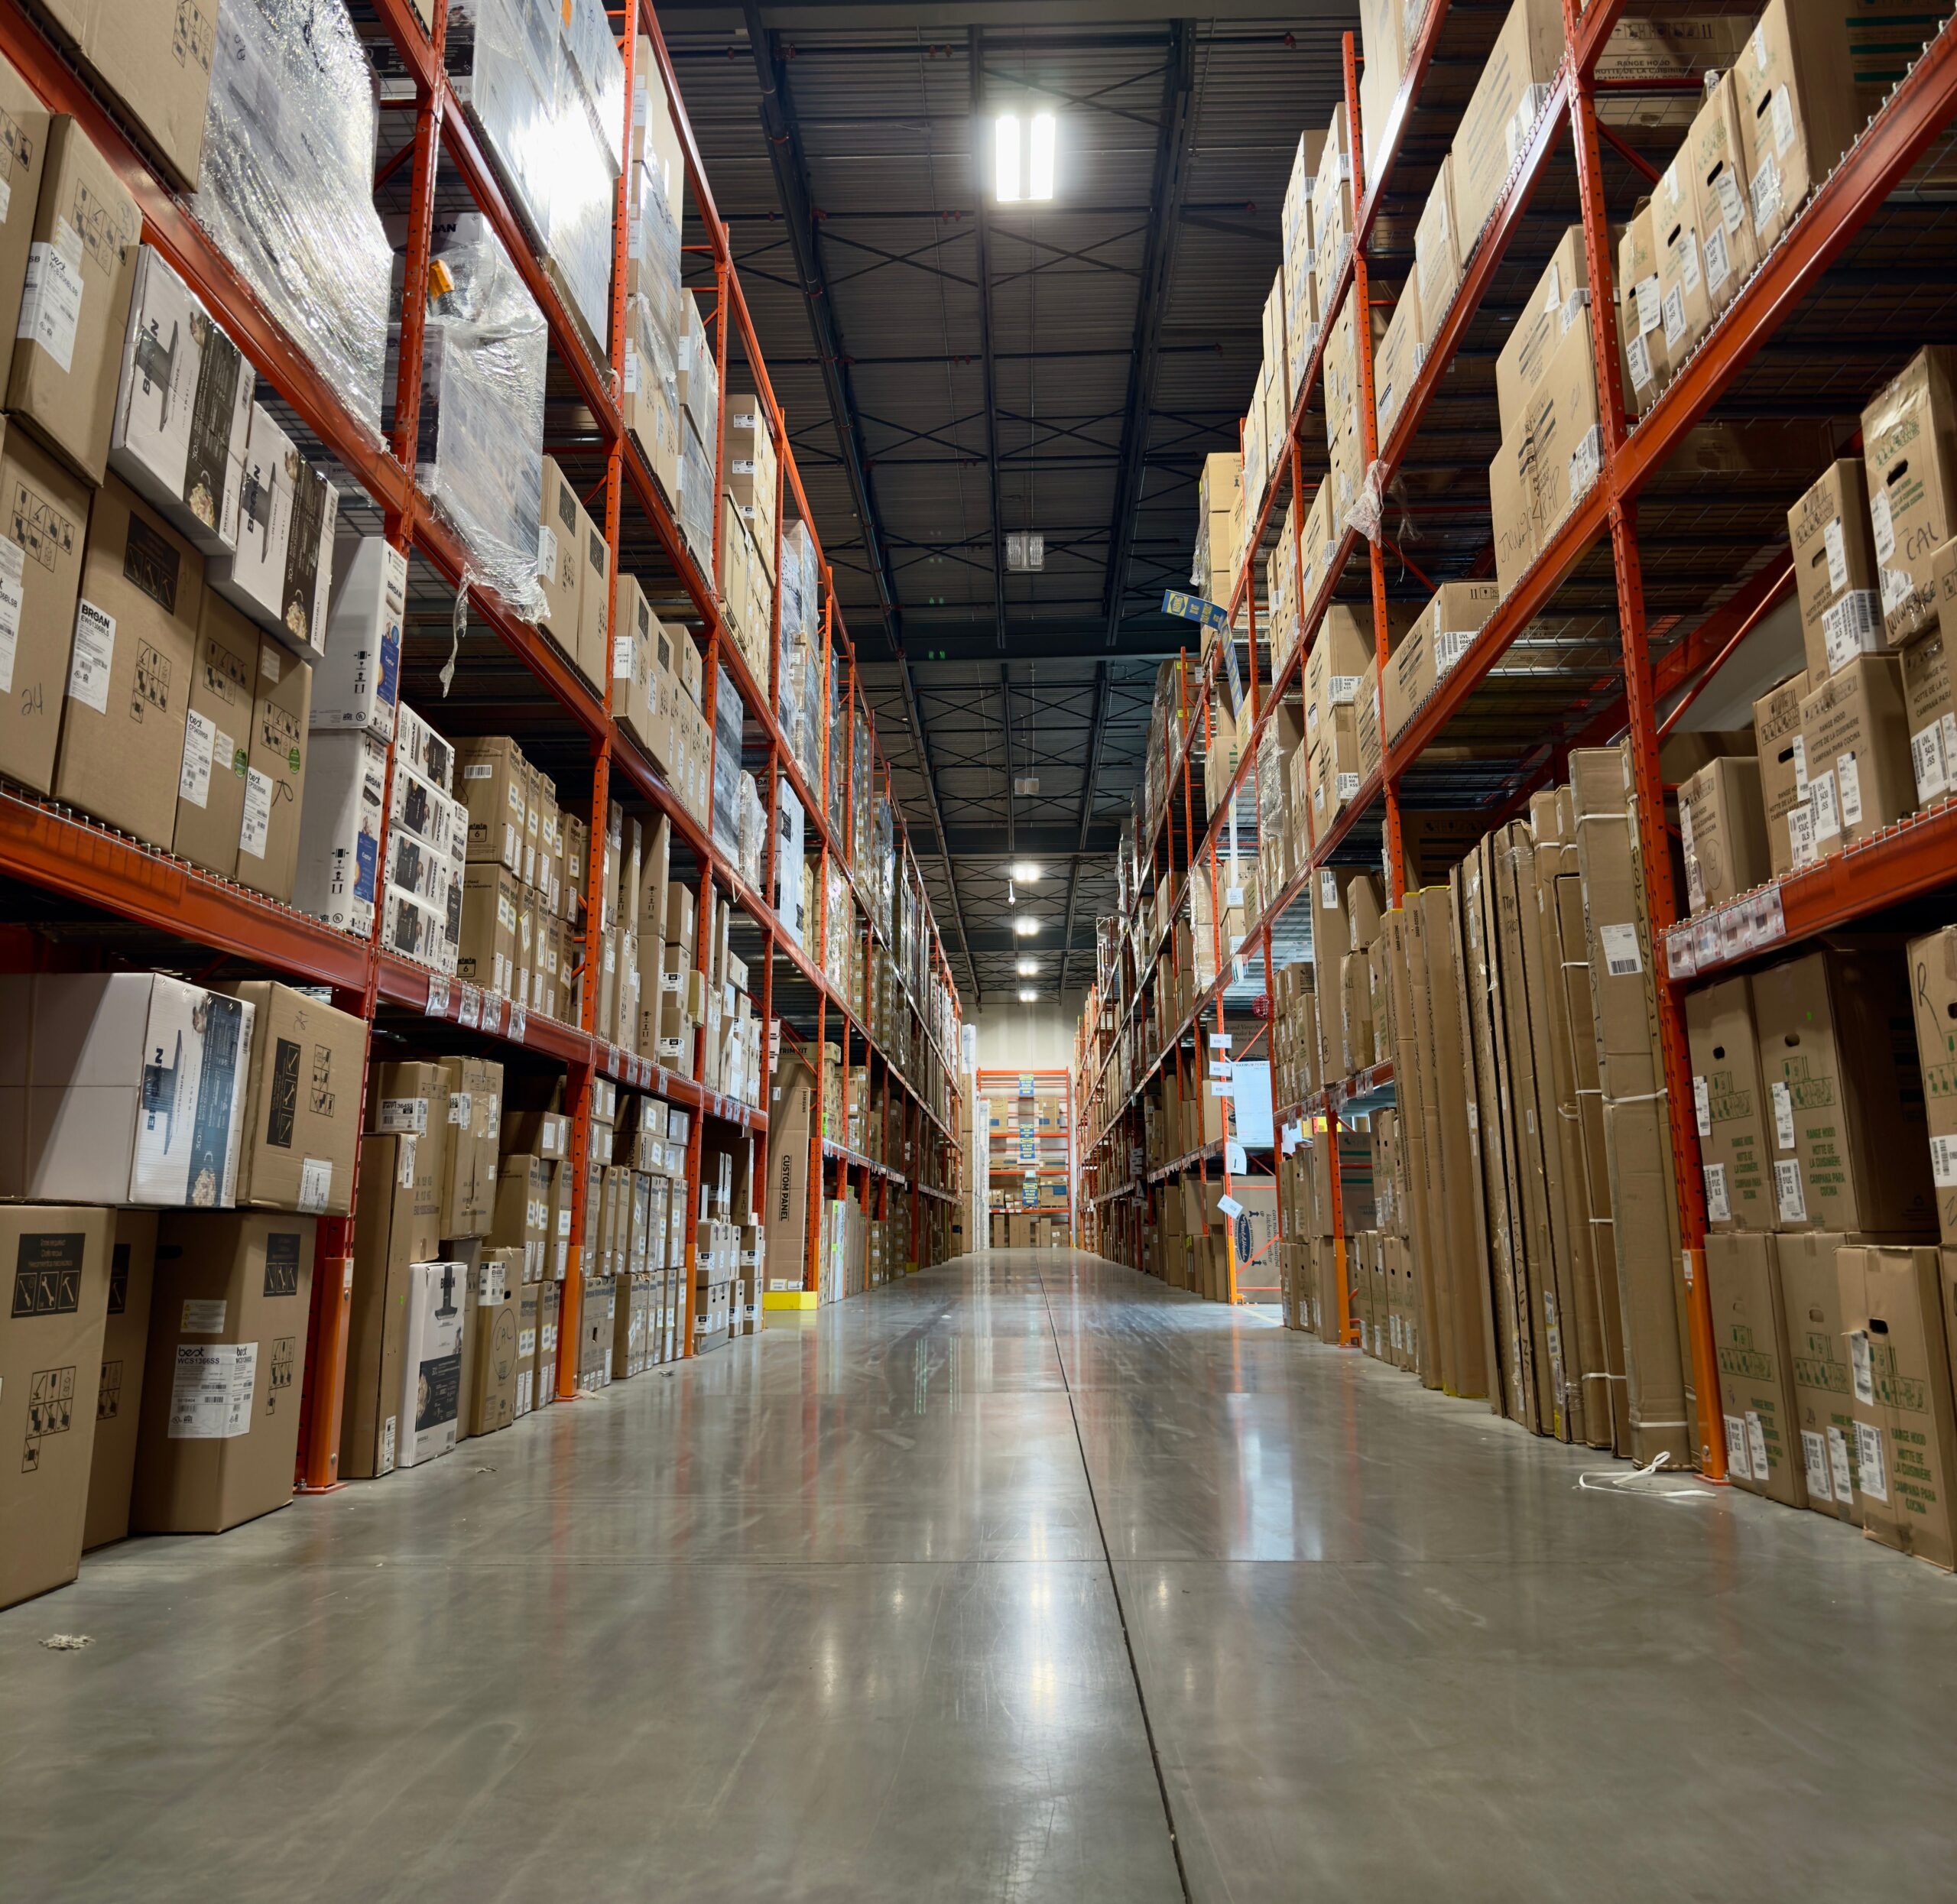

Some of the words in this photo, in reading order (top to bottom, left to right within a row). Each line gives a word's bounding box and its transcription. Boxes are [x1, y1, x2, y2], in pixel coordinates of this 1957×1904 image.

[1907, 522, 1939, 560] CAL
[387, 580, 403, 600] BROAN
[81, 604, 110, 629] BROAN
[21, 682, 44, 716] 24
[190, 713, 203, 728] best
[249, 770, 261, 784] best
[365, 774, 381, 790] BROAN
[627, 1134, 635, 1169] BROAN
[782, 1155, 790, 1189] CUSTOM
[781, 1192, 789, 1221] PANEL
[179, 1347, 204, 1357] best
[237, 1346, 247, 1357] best
